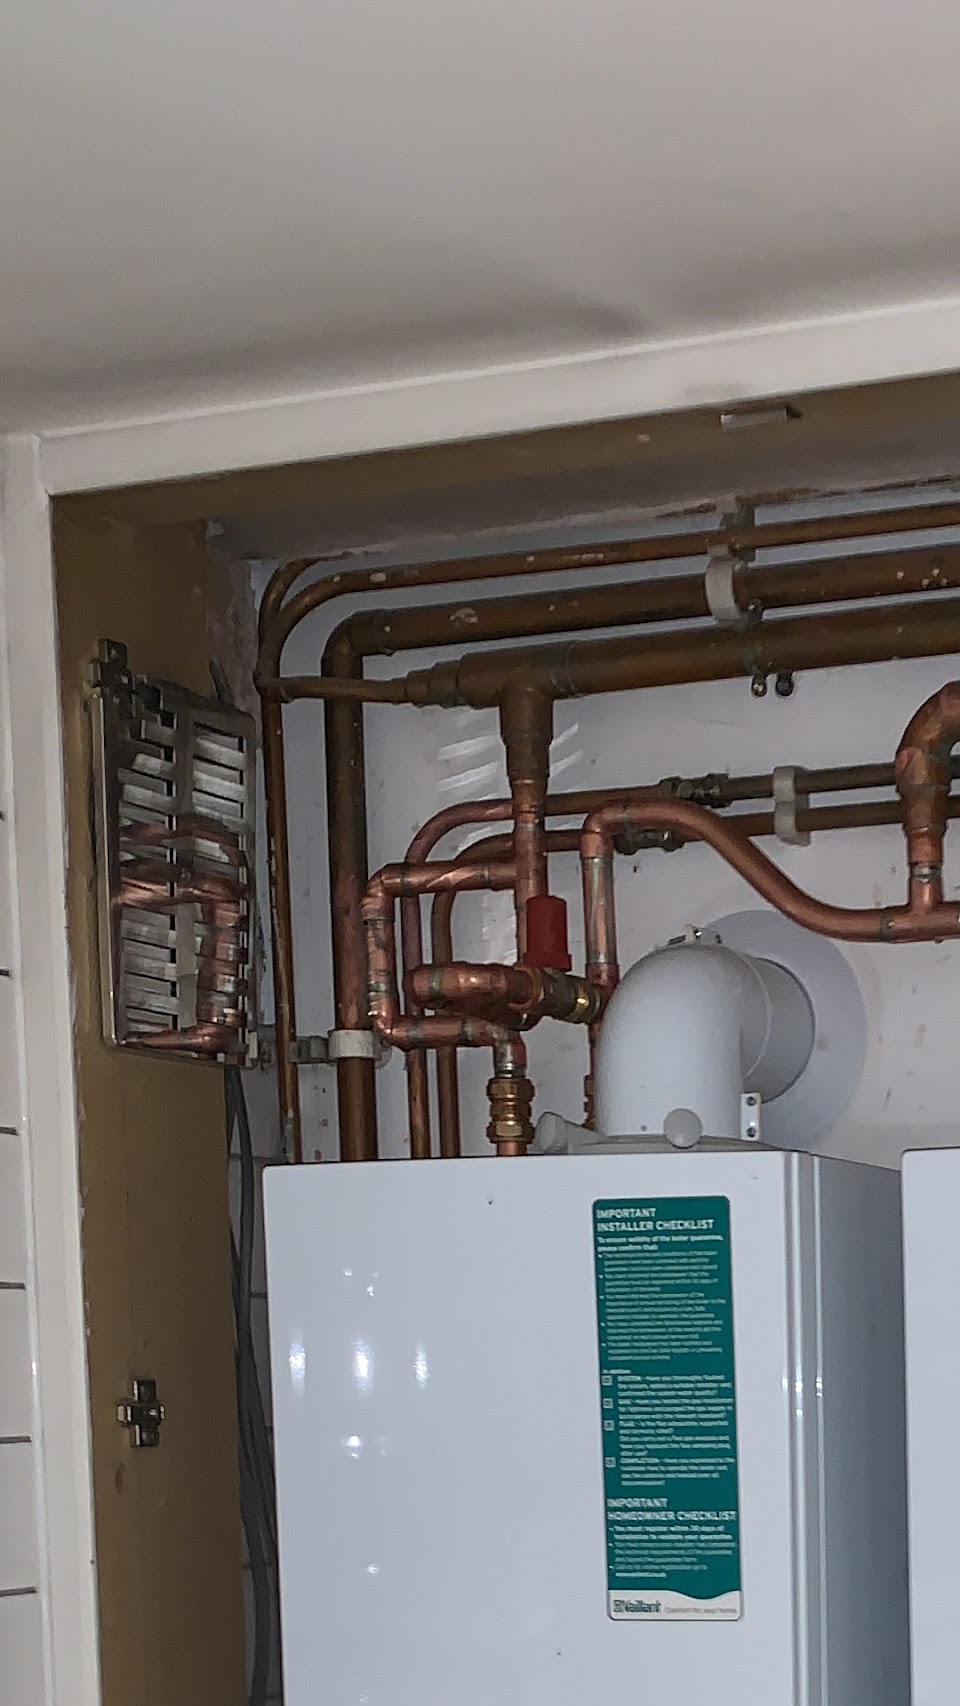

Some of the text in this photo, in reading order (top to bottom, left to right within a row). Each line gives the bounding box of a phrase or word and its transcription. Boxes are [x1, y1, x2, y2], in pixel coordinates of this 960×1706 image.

[596, 1208, 656, 1218] IMPORTANT
[597, 1219, 714, 1231] INSTALLER CHECKLIST
[607, 1498, 667, 1508] IMPORTANT
[607, 1511, 736, 1521] HOMEOWNER CHECKLIST
